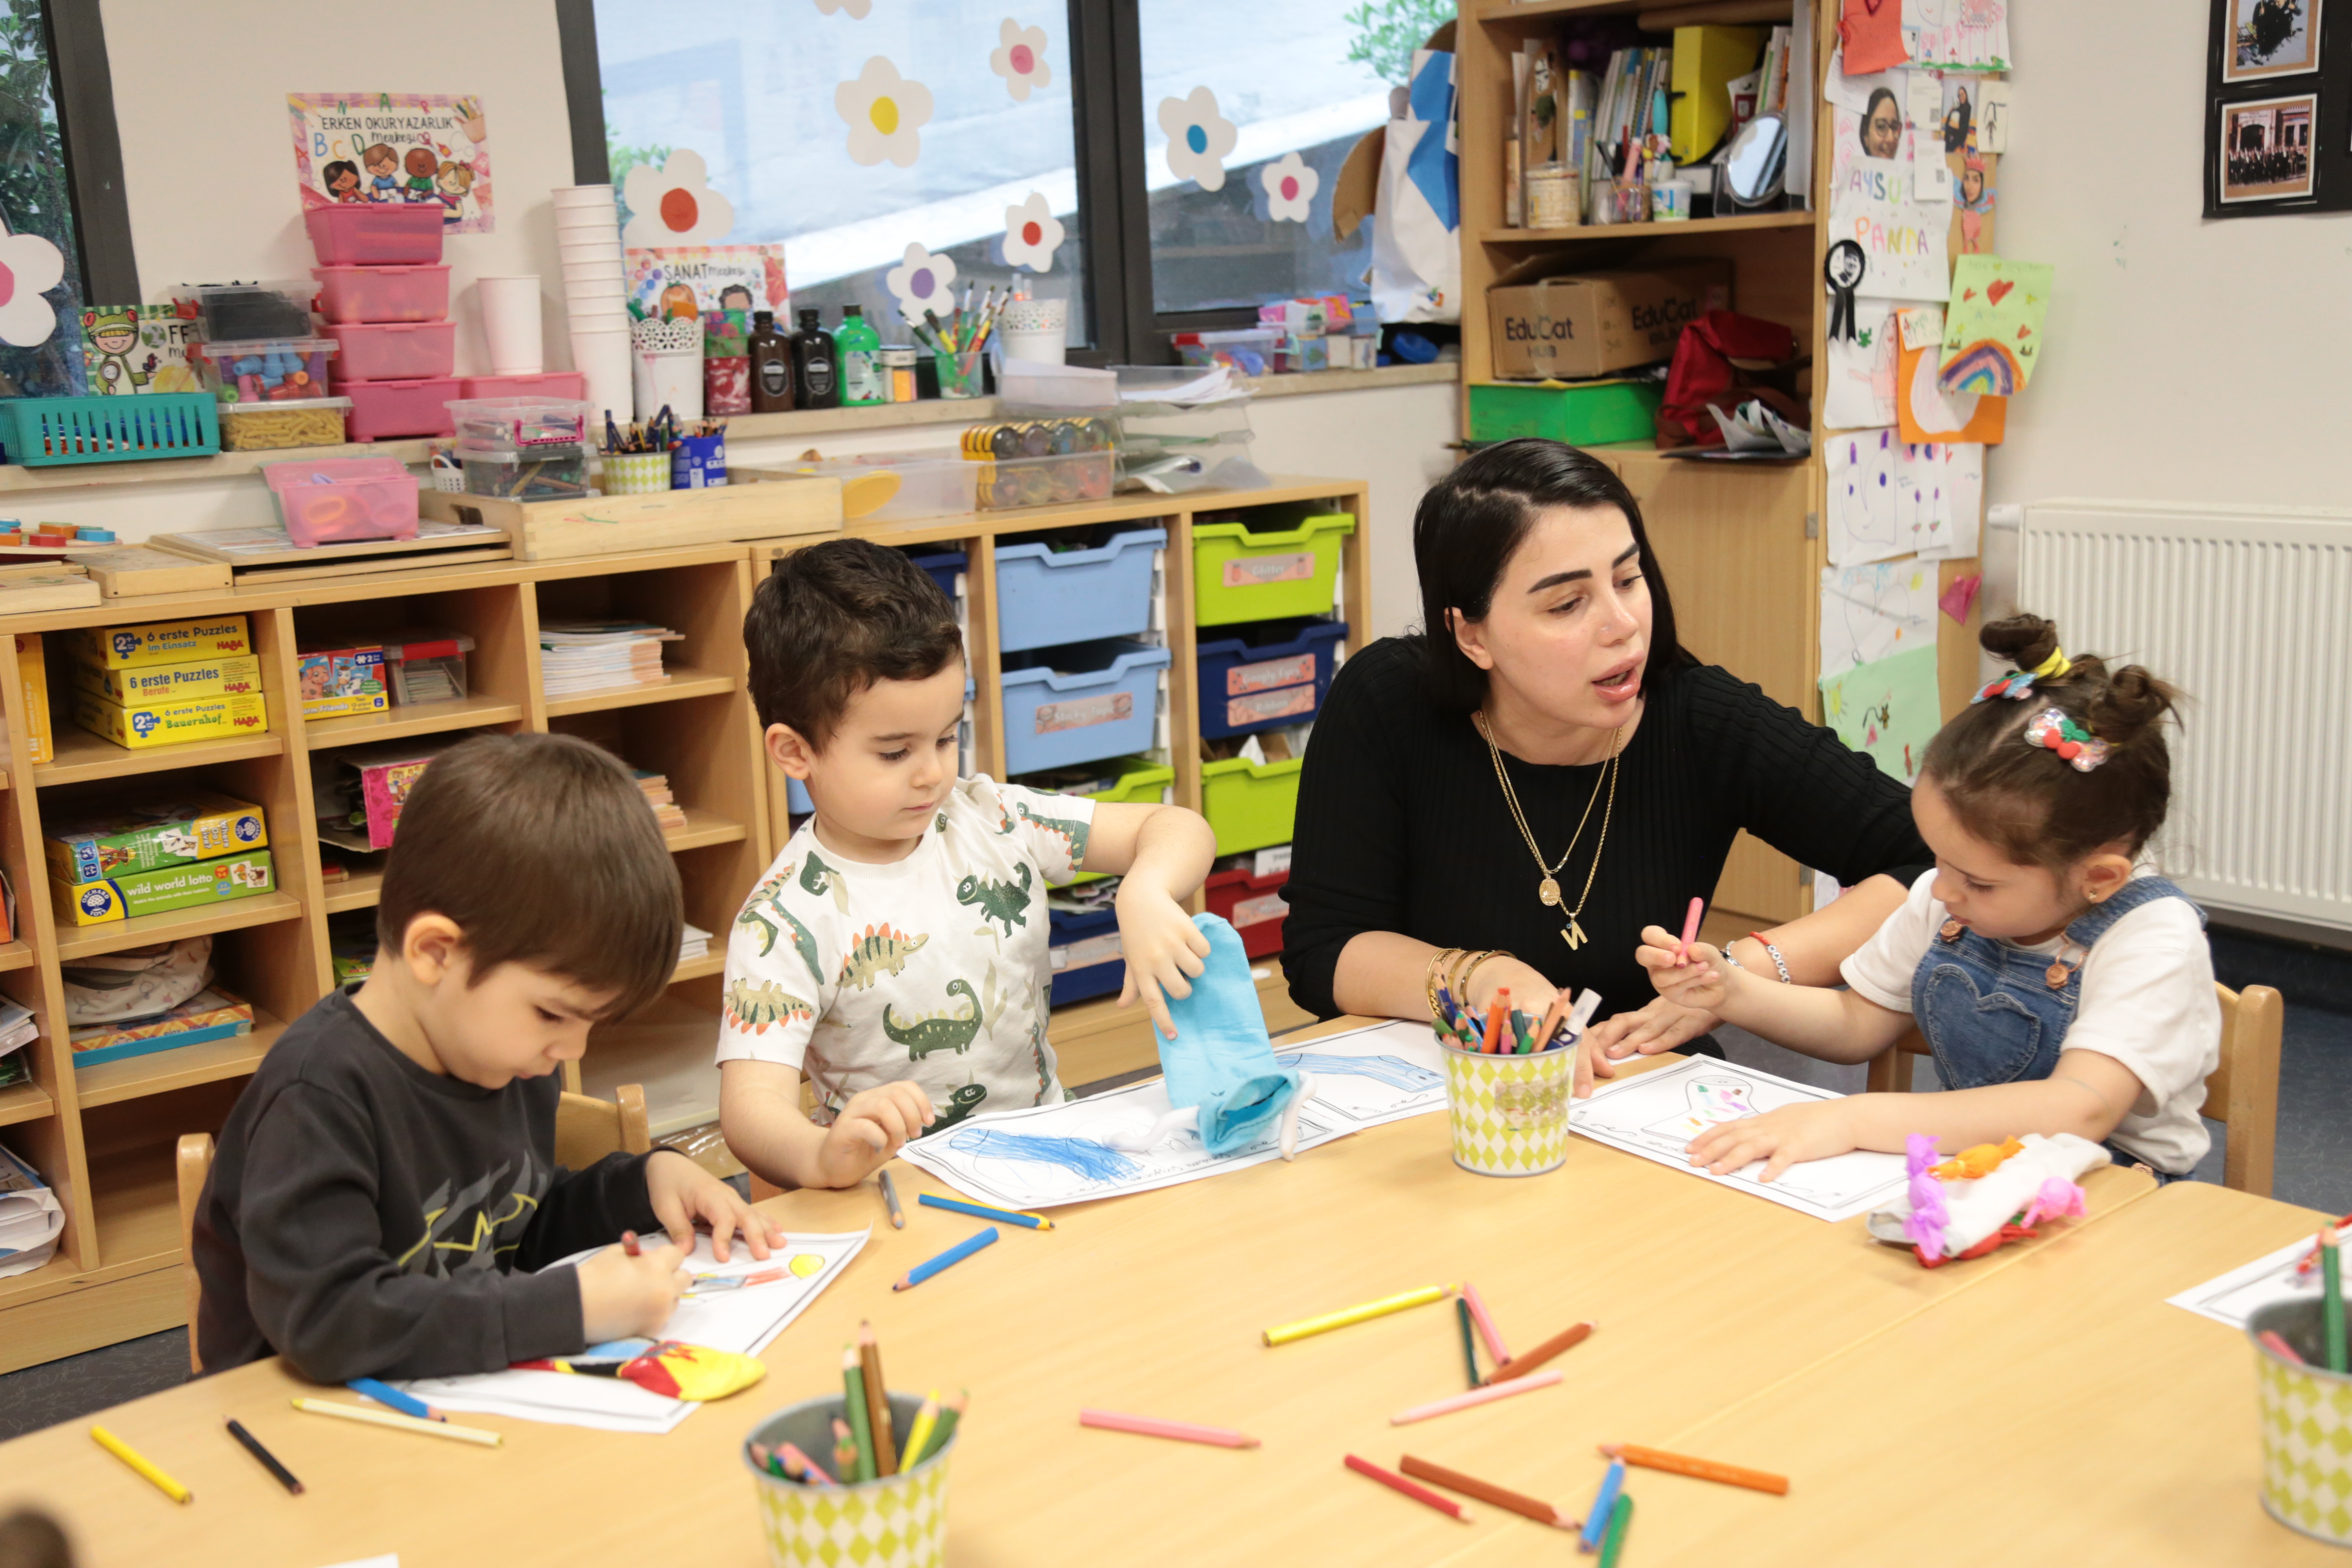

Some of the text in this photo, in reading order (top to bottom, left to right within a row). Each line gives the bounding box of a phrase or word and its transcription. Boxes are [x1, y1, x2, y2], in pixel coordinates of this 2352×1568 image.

[380, 93, 392, 113] A
[322, 117, 454, 130] ERKEN OKURYAZARLIK
[314, 132, 365, 159] B C D
[1855, 216, 1929, 256] PANDA
[664, 263, 707, 280] SANAT
[1505, 315, 1574, 340] EduCat
[147, 625, 238, 642] 6 erste Puzzles
[162, 640, 197, 650] Einsatz
[217, 639, 244, 651] HABA
[130, 677, 138, 689] 6
[141, 674, 171, 687] erste
[174, 668, 219, 683] Puzzles
[143, 686, 170, 697] Berufe
[224, 681, 251, 693] HABA
[173, 707, 193, 716] erste
[196, 703, 226, 712] Puzzles
[165, 713, 222, 729] Bauernhof
[233, 715, 260, 727] HABA
[220, 820, 230, 848] Where
[127, 874, 213, 897] wild world lotto
[82, 888, 110, 903] ORCHARD
[89, 908, 107, 917] TOYS
